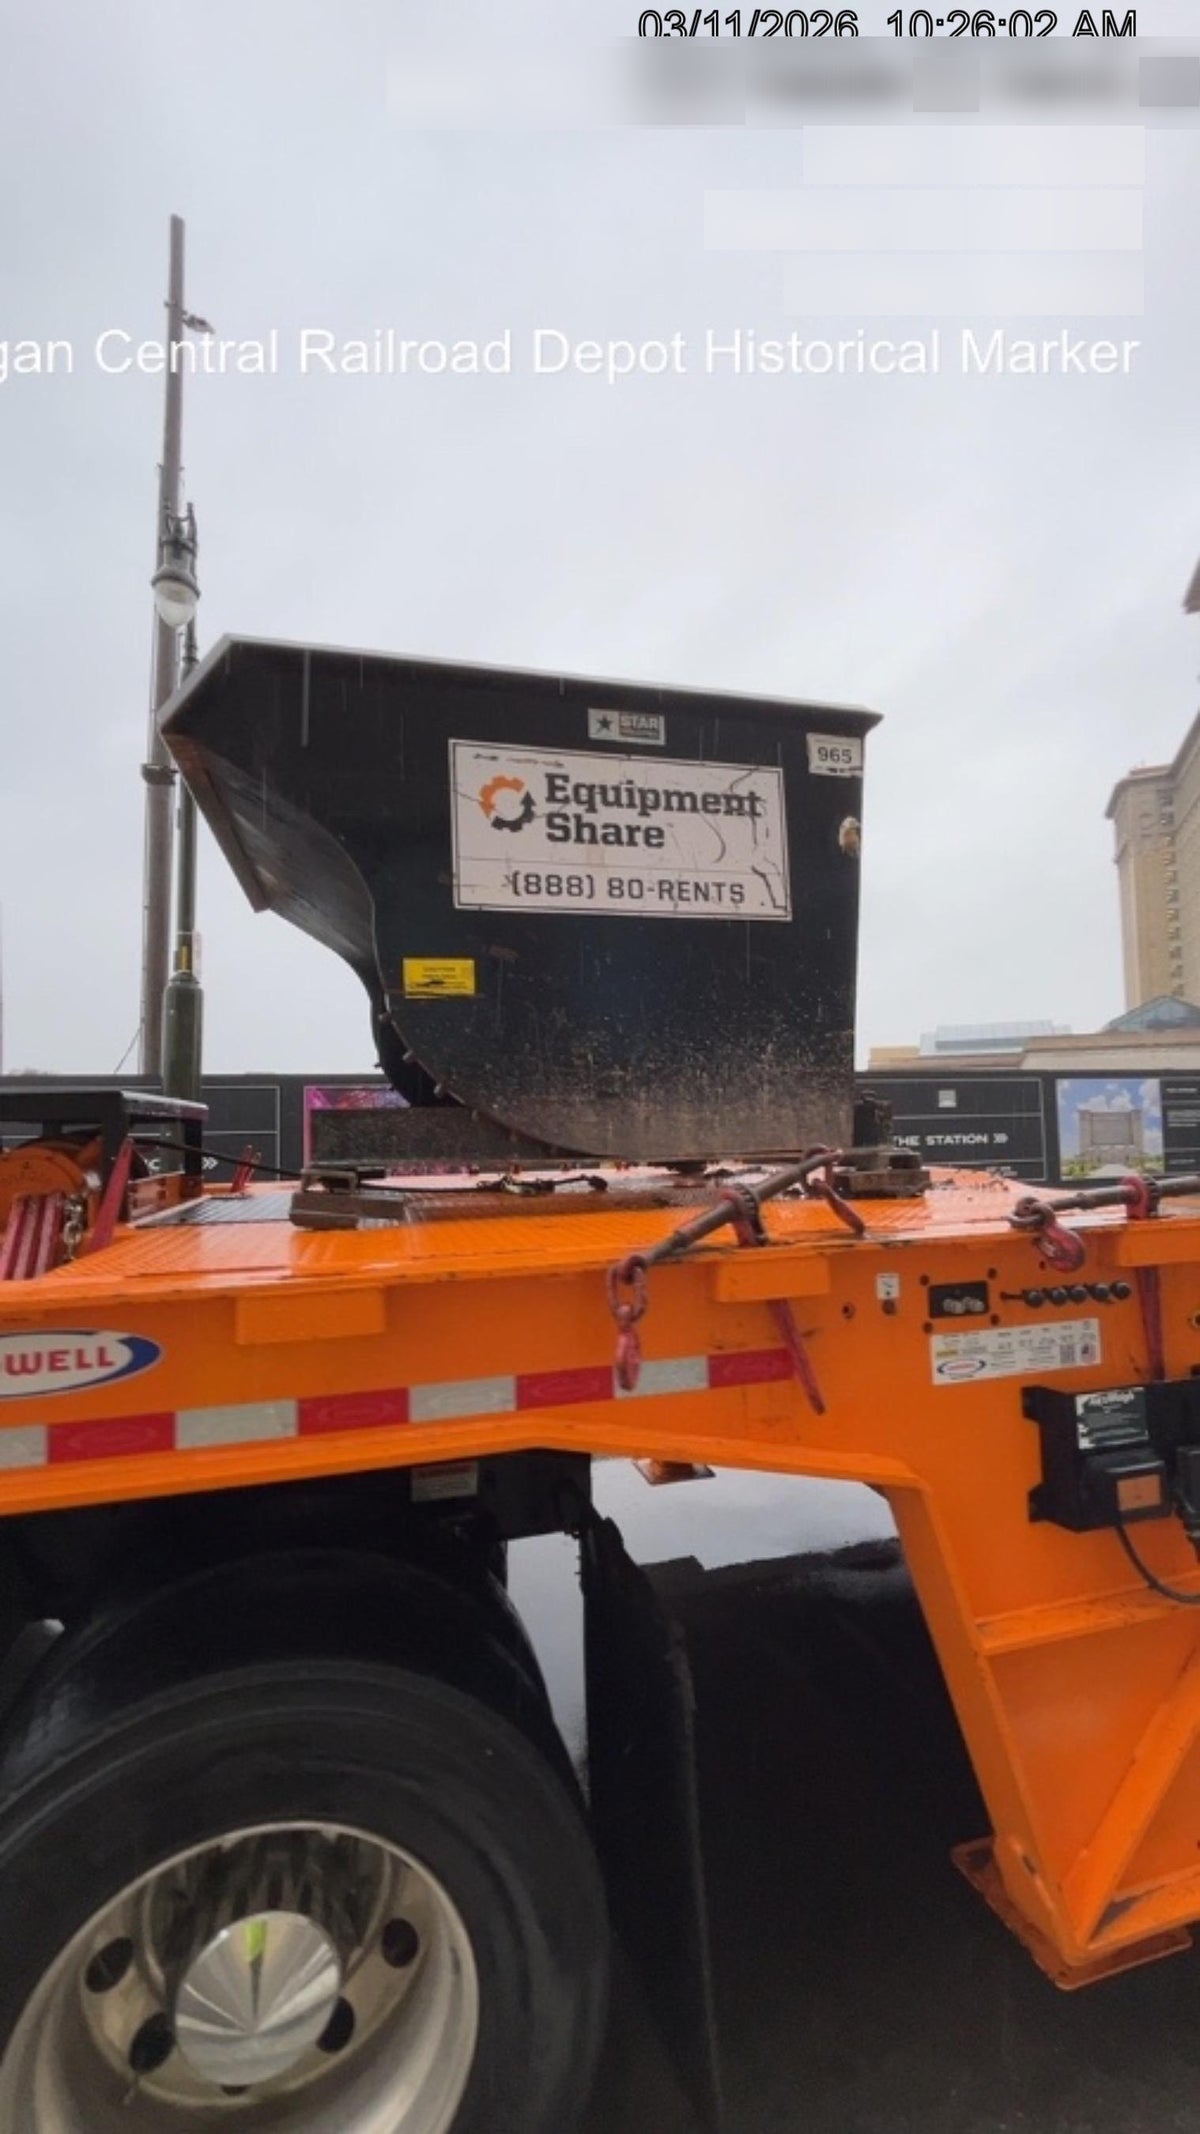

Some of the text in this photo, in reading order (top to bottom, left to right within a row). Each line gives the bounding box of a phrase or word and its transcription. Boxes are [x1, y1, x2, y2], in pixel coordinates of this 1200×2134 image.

[817, 746, 852, 765] 965
[545, 773, 761, 817] Equipment
[545, 812, 665, 848] Share
[511, 871, 745, 904] (888) 80-RENTS
[926, 1132, 988, 1147] STATION
